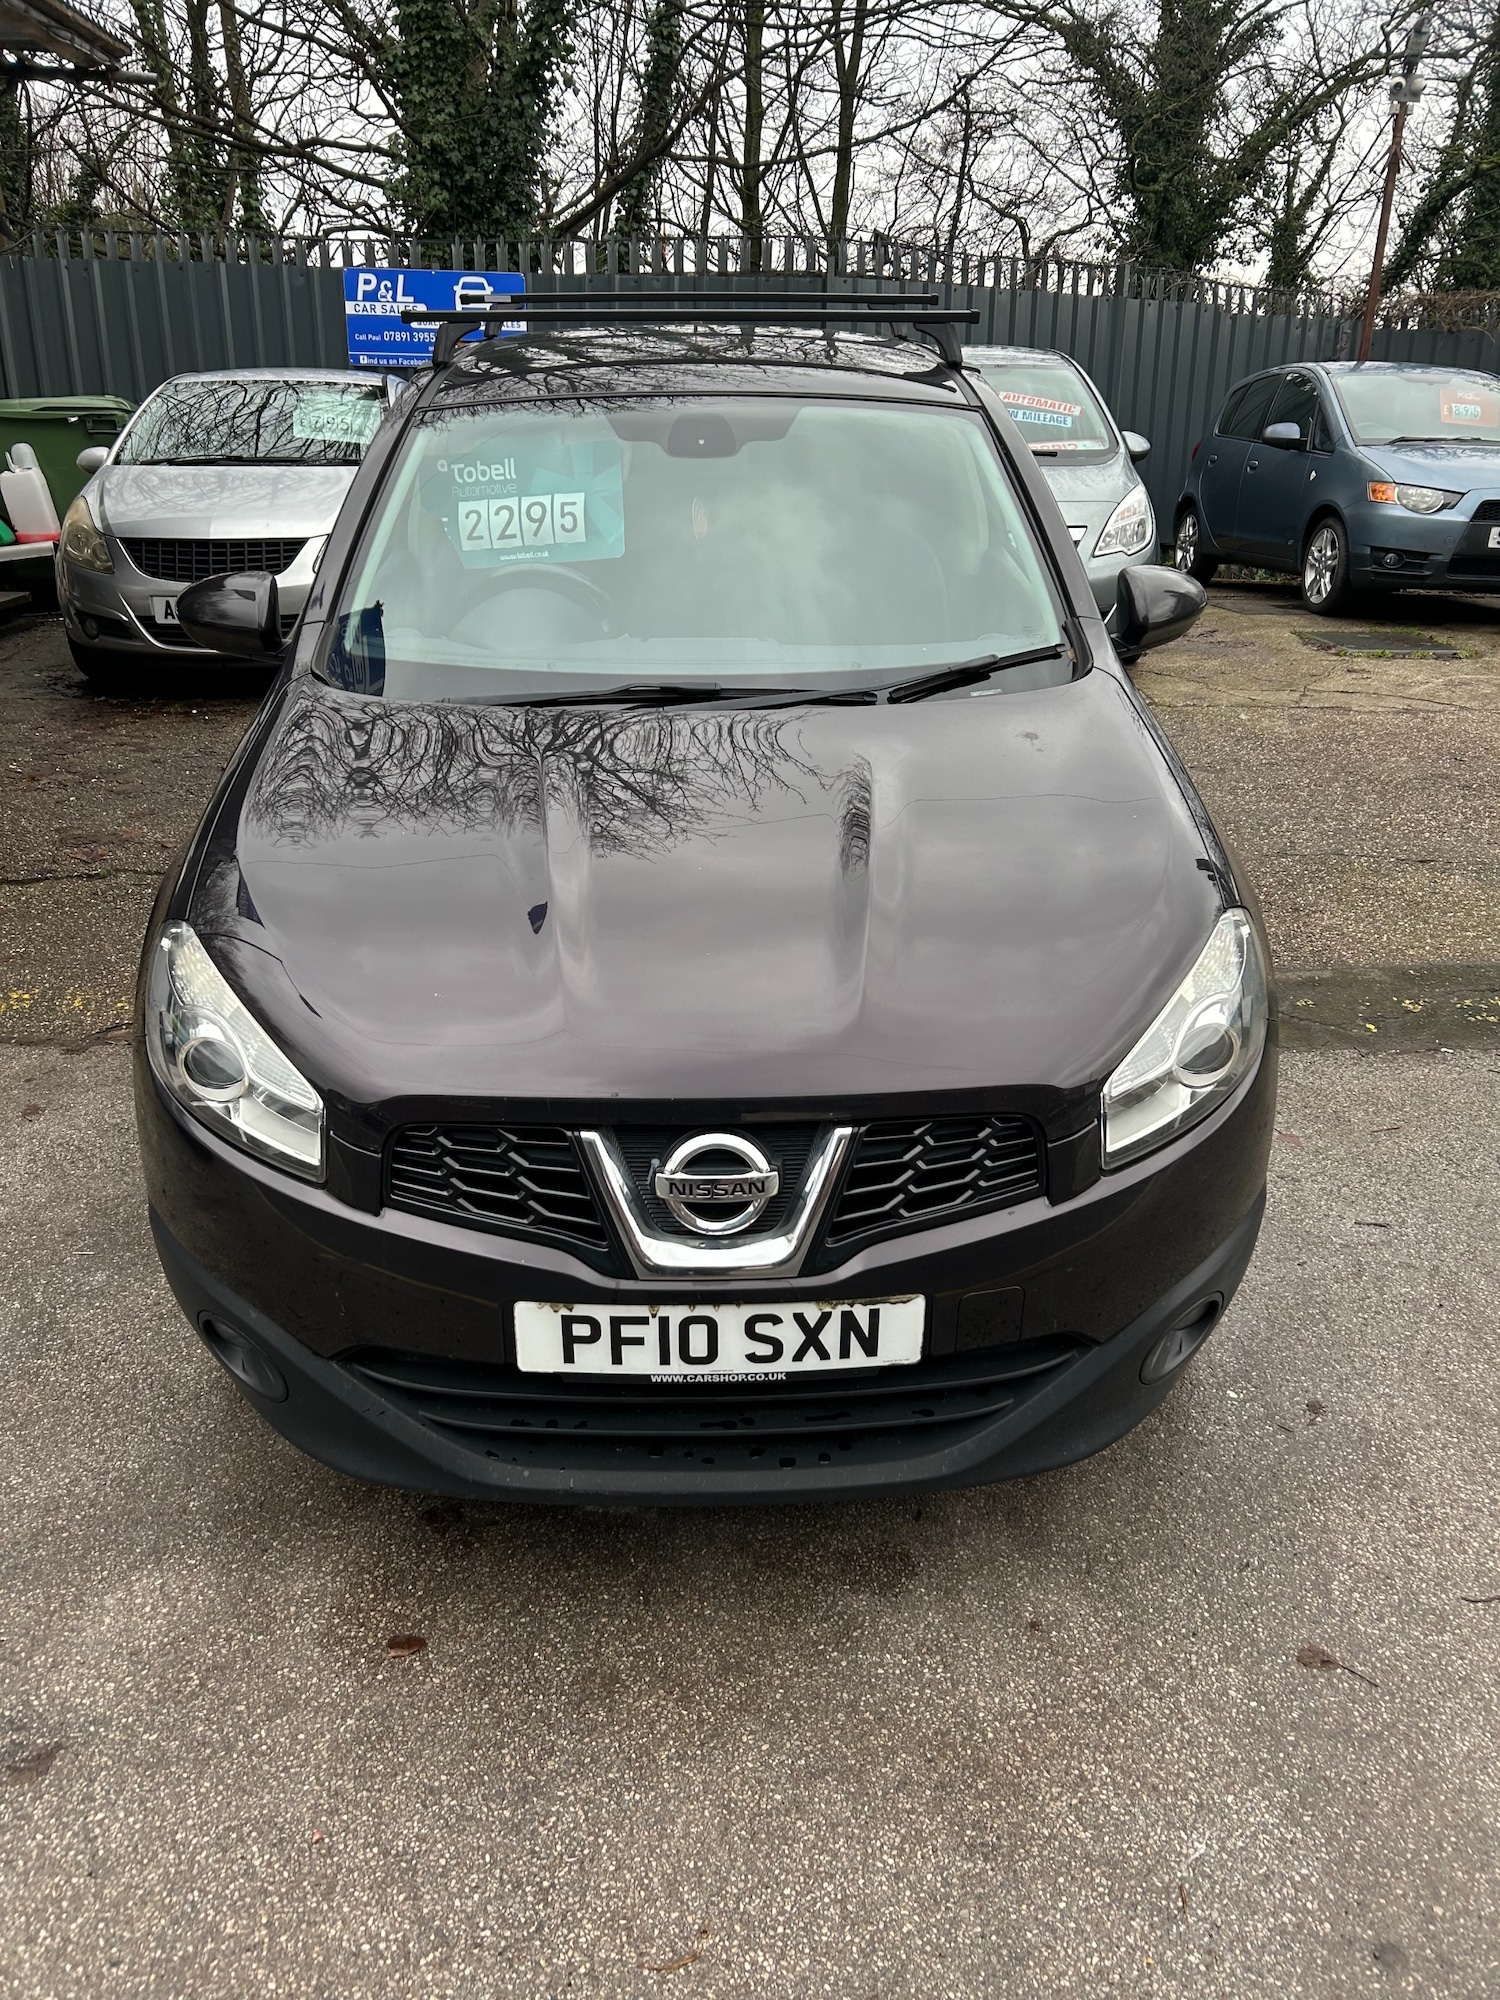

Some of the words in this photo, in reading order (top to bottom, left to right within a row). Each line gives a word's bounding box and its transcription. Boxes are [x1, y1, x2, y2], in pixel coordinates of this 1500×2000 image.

[357, 272, 414, 303] P&L
[353, 303, 377, 314] CAR
[354, 333, 367, 341] Call
[383, 330, 410, 342] 07891
[412, 332, 437, 343] 3955
[1002, 391, 1077, 413] AUTOMATIC
[1022, 411, 1069, 426] MILEAGE
[450, 457, 517, 484] Tobell
[451, 483, 518, 498] Automotive
[464, 501, 578, 541] 2295
[164, 599, 177, 620] A
[669, 1181, 766, 1197] NISSAN
[560, 1313, 719, 1367] PF10
[743, 1308, 881, 1364] SXN
[650, 1371, 787, 1384] WWW.CARSHOP.CO.UK
